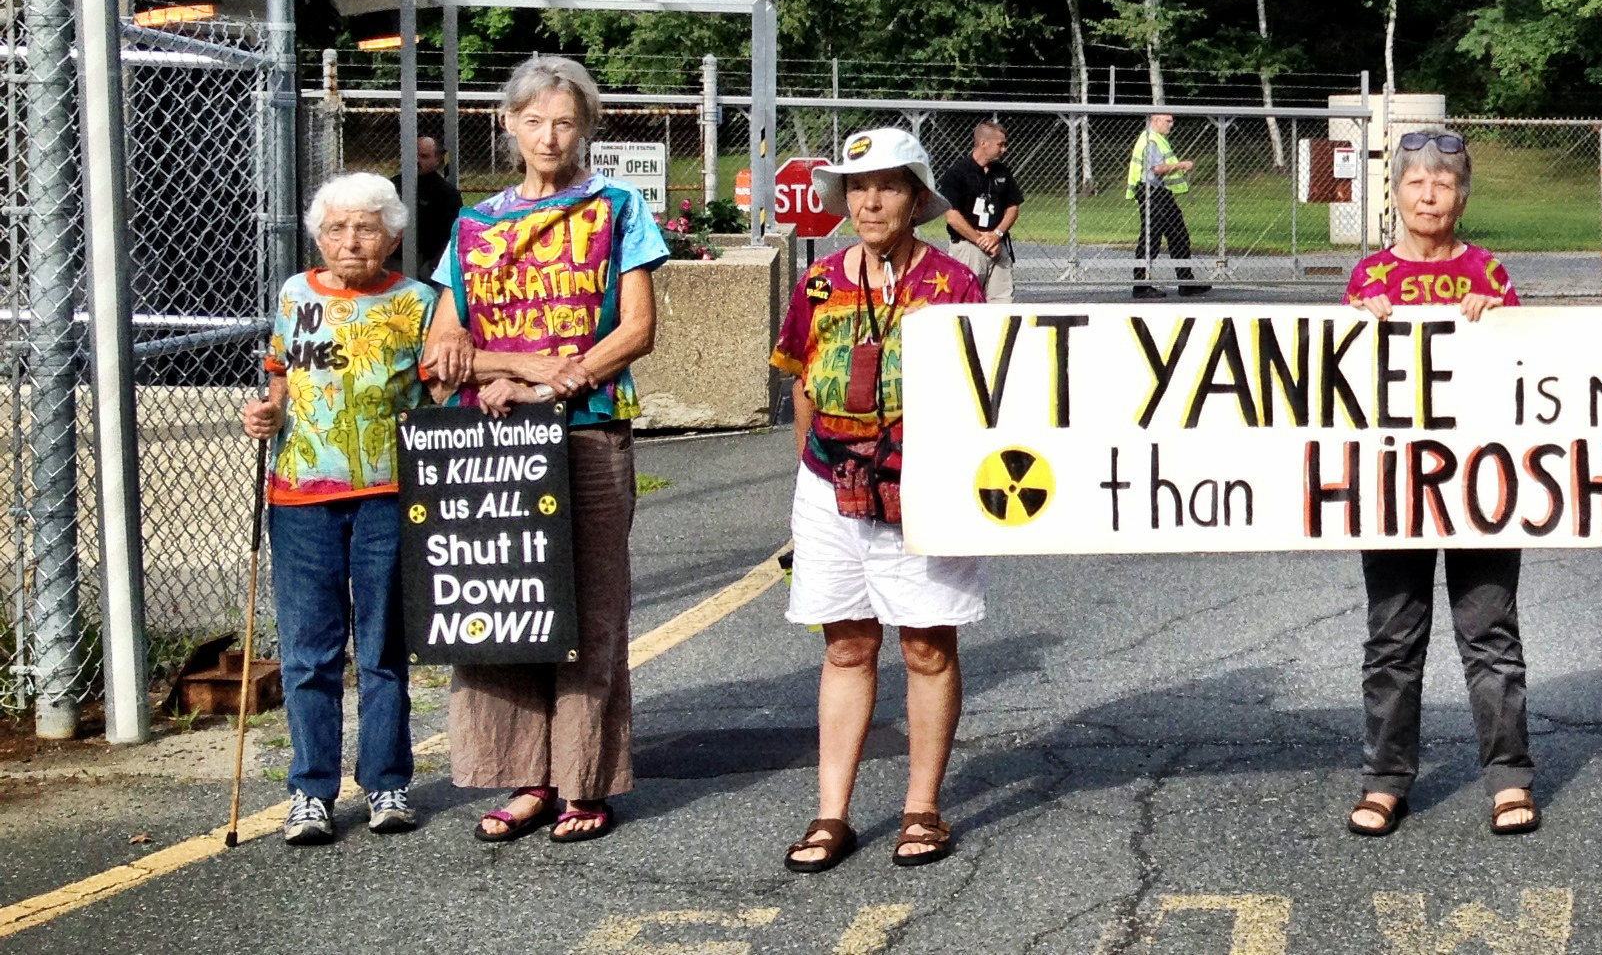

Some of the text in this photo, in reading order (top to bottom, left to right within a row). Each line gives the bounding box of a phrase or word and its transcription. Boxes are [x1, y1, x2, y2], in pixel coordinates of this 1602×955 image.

[594, 154, 619, 166] MAIN
[596, 168, 616, 177] OT
[626, 160, 657, 173] OPEN
[638, 188, 658, 201] EN
[774, 183, 824, 213] STO
[466, 199, 609, 269] STOP
[1400, 274, 1472, 302] STOP
[293, 302, 323, 338] NO
[955, 315, 1089, 429] VT
[1126, 316, 1457, 431] YANKEE
[400, 419, 563, 451] Vermont Yankee
[417, 454, 548, 486] is KILLING
[1100, 443, 1254, 532] than
[439, 490, 530, 520] us ALL.
[426, 530, 548, 567] Shut It
[433, 573, 545, 606] Down
[427, 610, 555, 645] NOW!!
